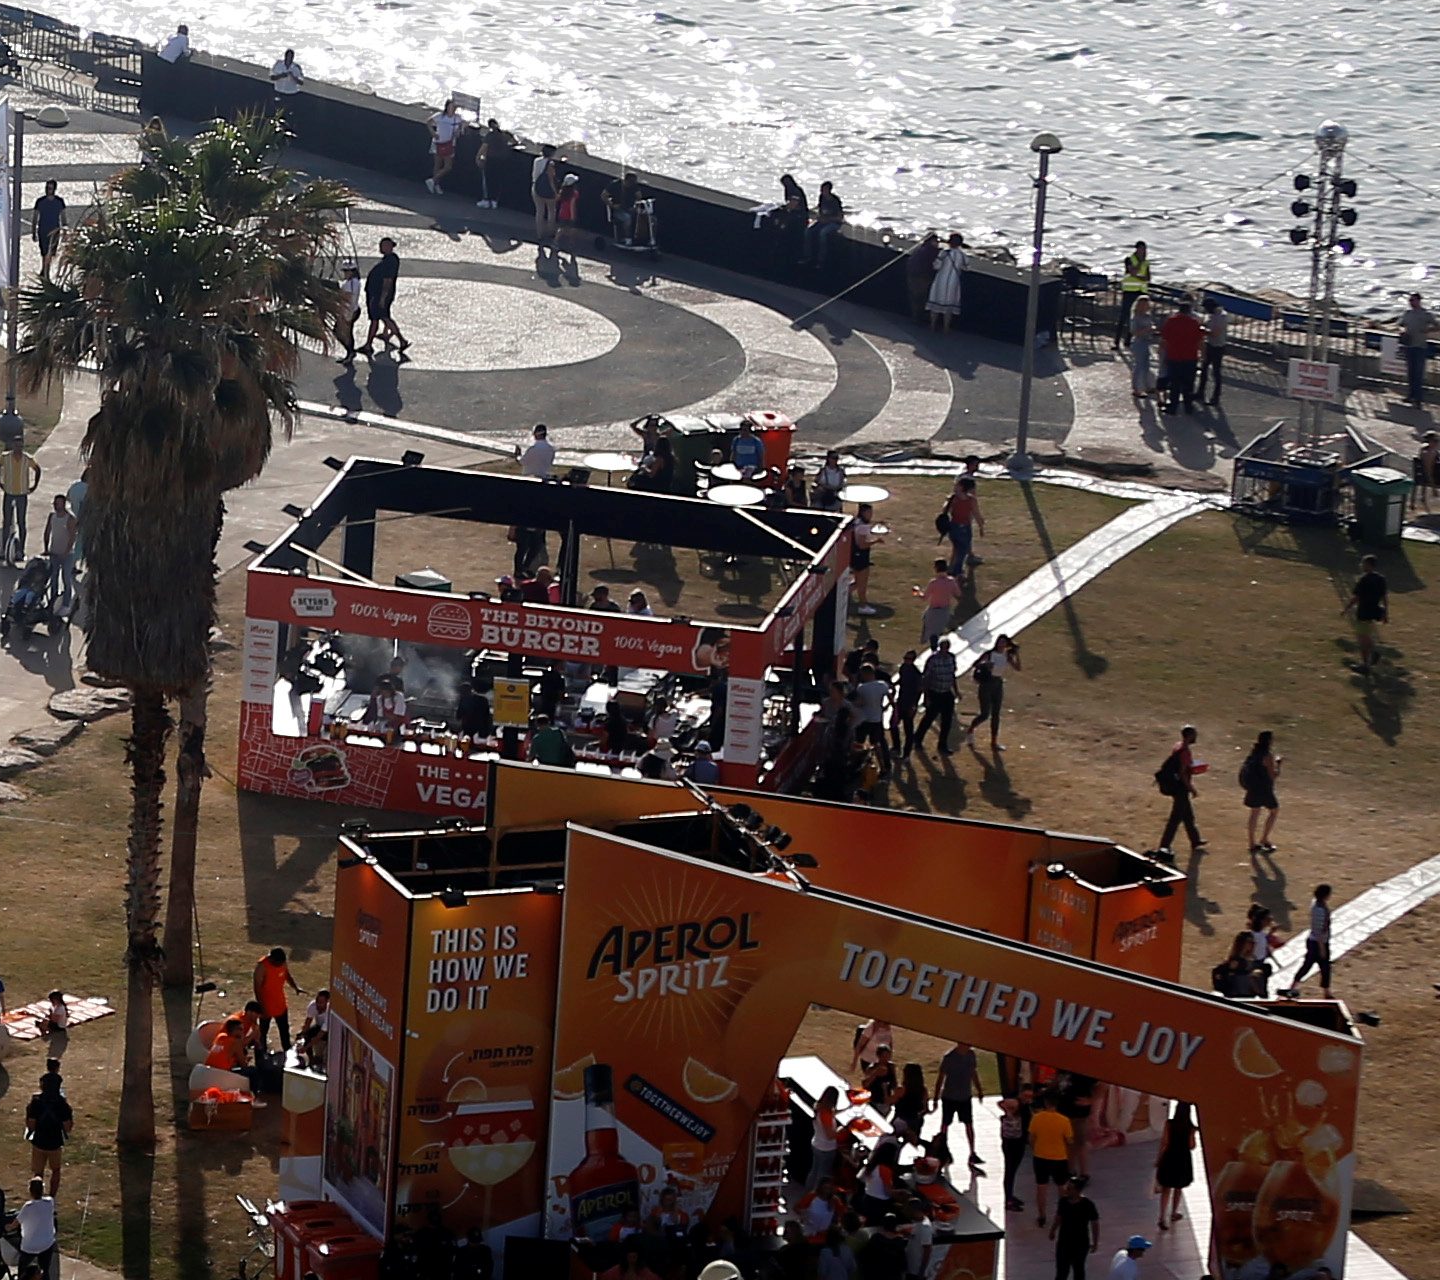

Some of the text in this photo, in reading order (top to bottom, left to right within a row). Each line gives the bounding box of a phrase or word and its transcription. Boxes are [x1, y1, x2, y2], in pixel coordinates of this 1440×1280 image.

[348, 602, 418, 624] 100% Vegan
[481, 608, 604, 635] THE BEYOND
[481, 626, 600, 657] BURGER
[614, 635, 683, 656] 100% Vegan
[430, 925, 517, 954] THIS IS
[586, 912, 760, 980] APEROL
[429, 953, 529, 984] HOW WE
[426, 985, 491, 1014] DO IT
[839, 942, 1204, 1071] TOGETHER WE JOY
[507, 1044, 534, 1057] פלח
